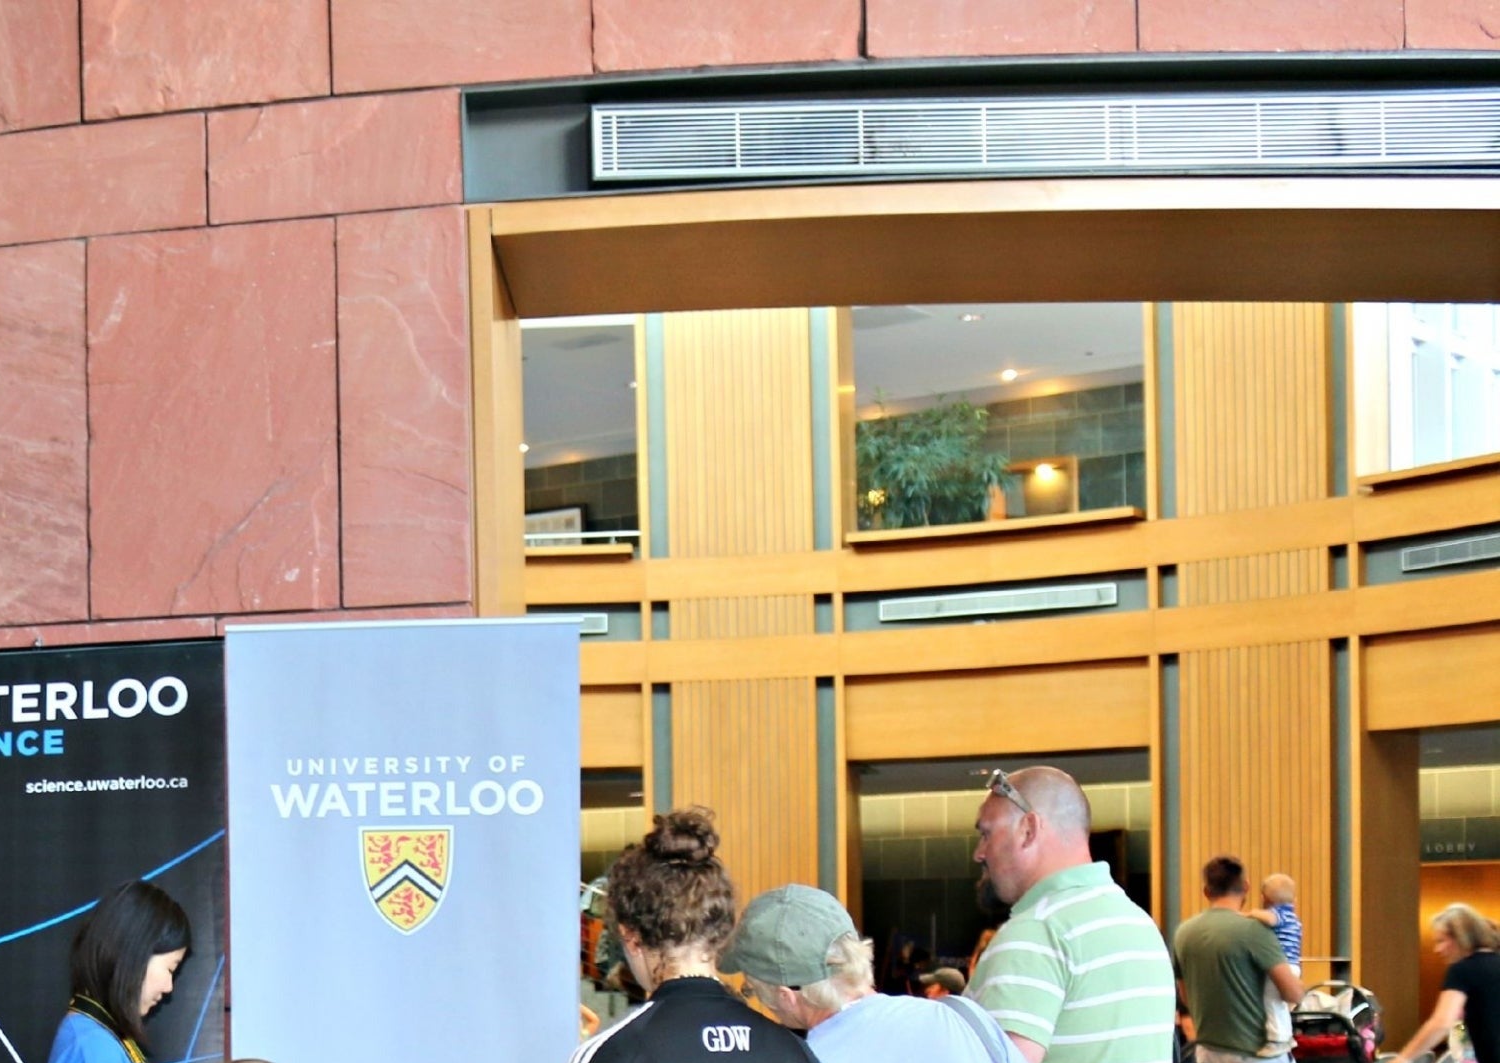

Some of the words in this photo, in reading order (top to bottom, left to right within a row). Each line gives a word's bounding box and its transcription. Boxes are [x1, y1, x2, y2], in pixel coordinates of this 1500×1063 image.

[286, 755, 472, 776] UNIVERSITY
[488, 755, 526, 774] OF
[25, 775, 189, 793] science.uwaterloo.ca
[270, 779, 544, 818] WATERLOO
[702, 1025, 751, 1052] GDW
